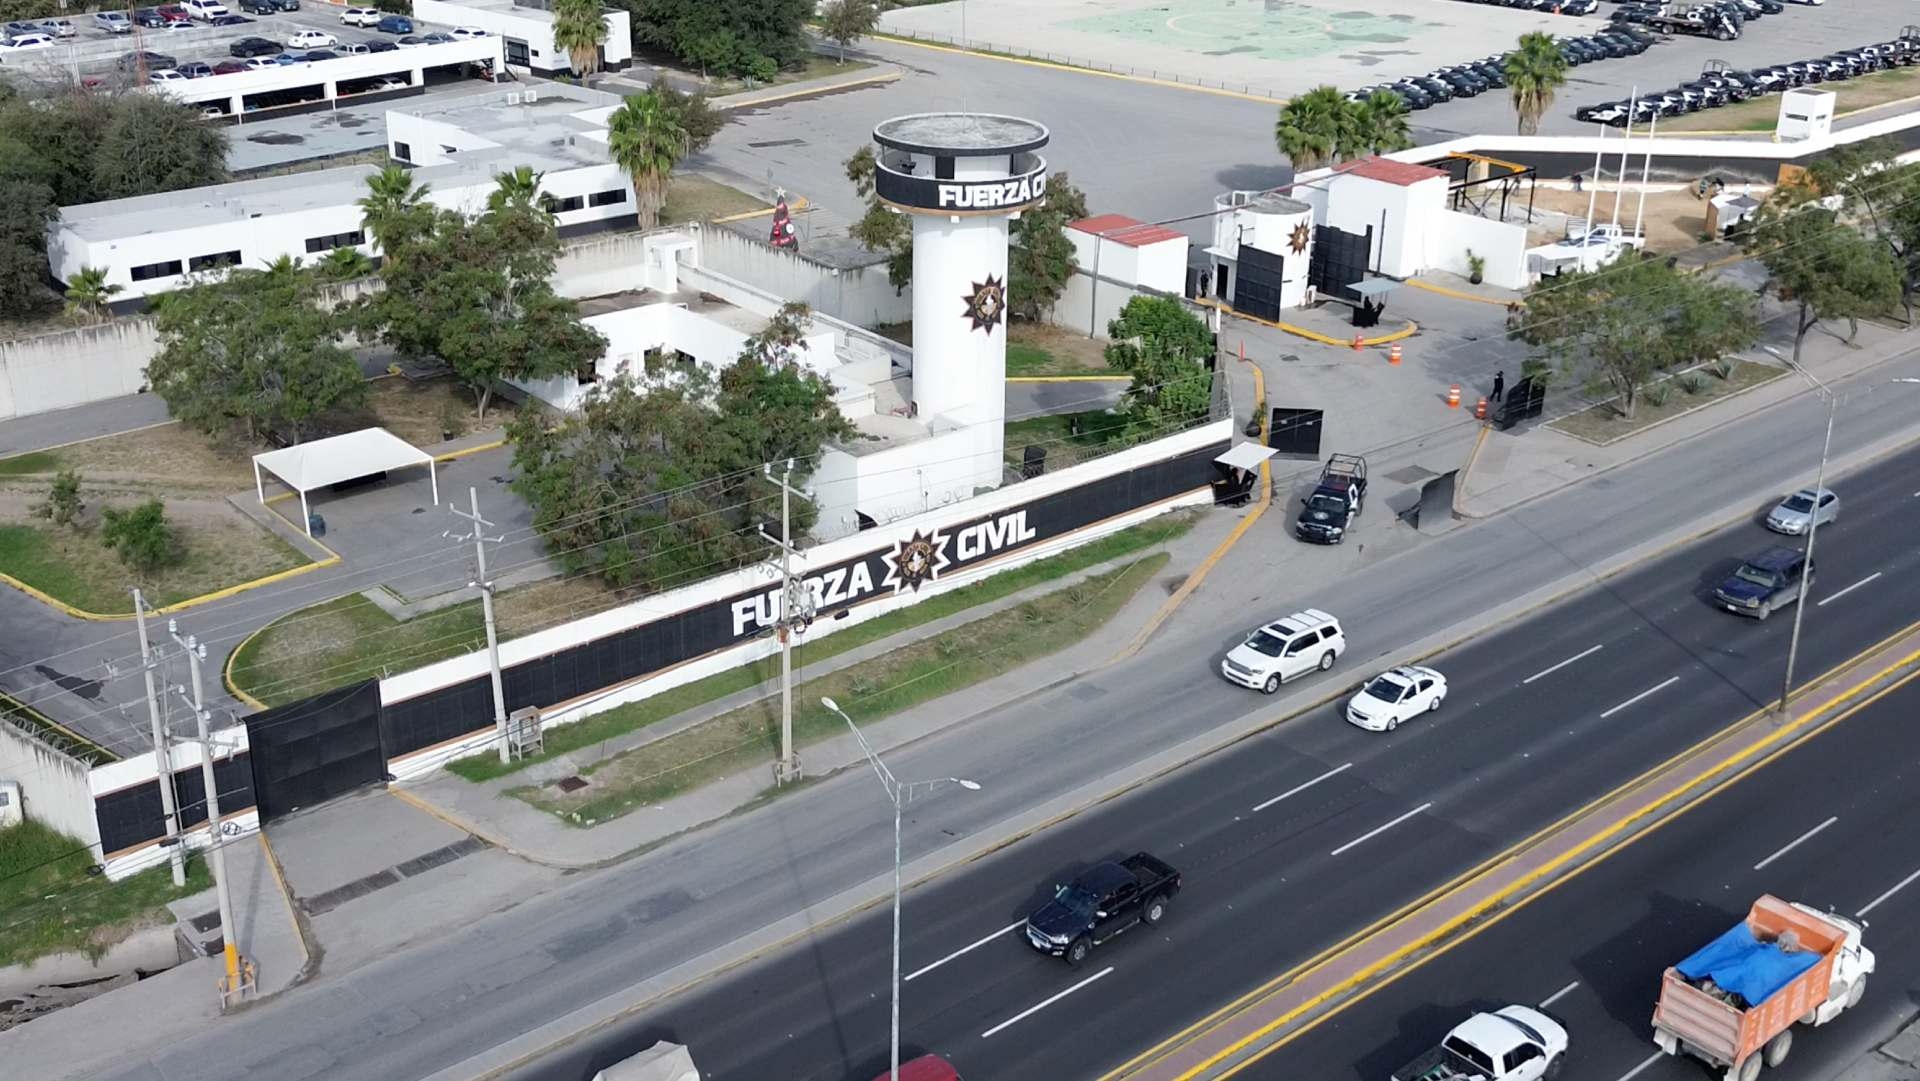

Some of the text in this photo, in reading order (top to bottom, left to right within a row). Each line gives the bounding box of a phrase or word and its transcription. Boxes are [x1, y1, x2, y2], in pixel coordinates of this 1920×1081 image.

[938, 178, 1031, 207] FUERZA
[731, 561, 873, 636] FURZA
[957, 510, 1036, 561] CIVIL
